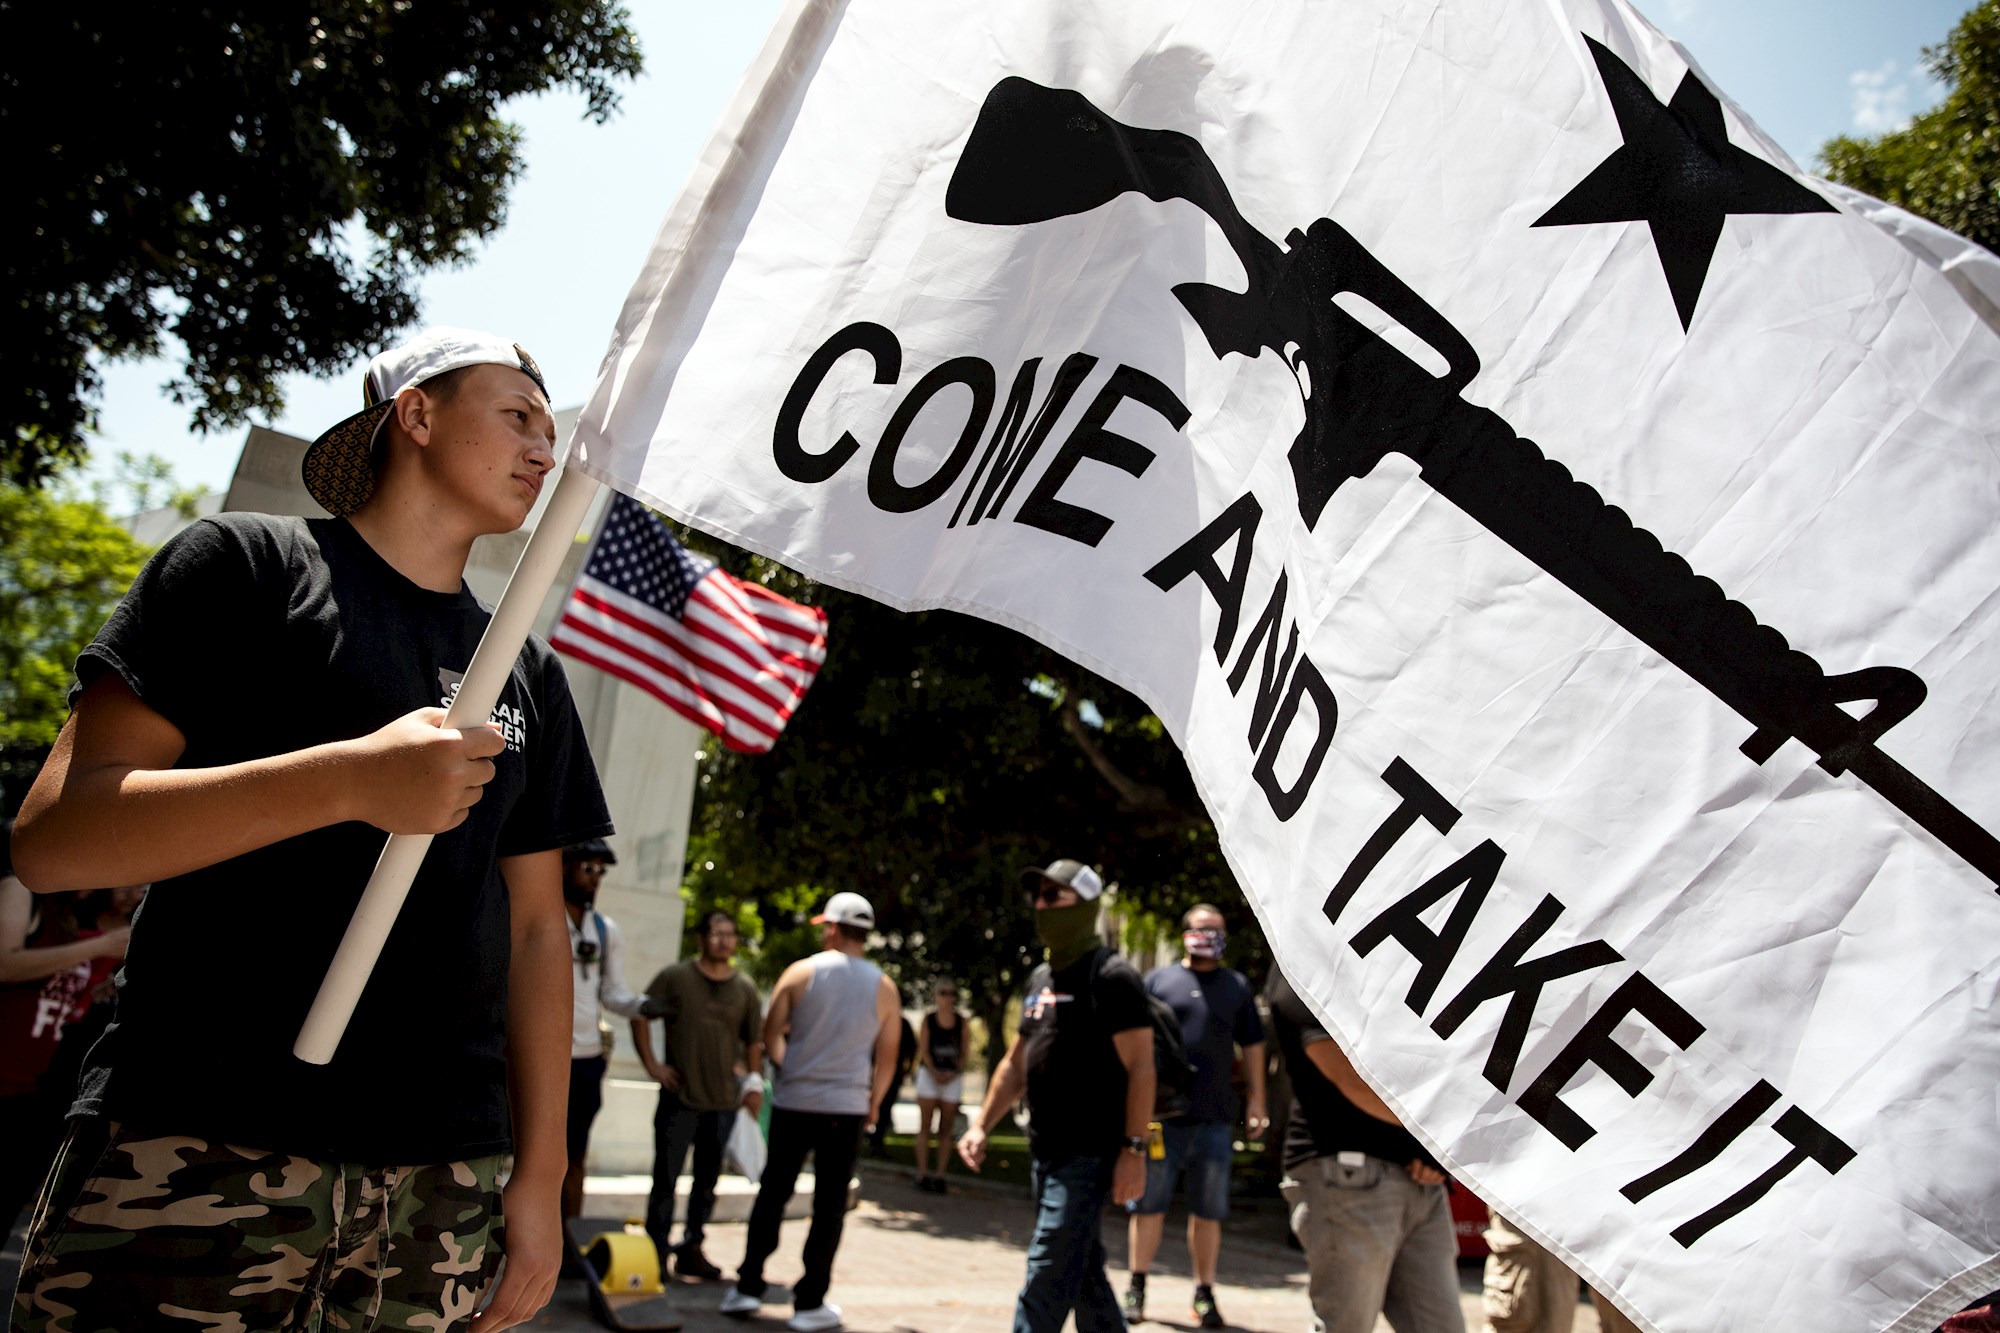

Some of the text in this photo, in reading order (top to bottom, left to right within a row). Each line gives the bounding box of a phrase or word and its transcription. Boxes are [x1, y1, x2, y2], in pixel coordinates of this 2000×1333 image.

[773, 322, 1857, 1249] COME AND TAKE IT
